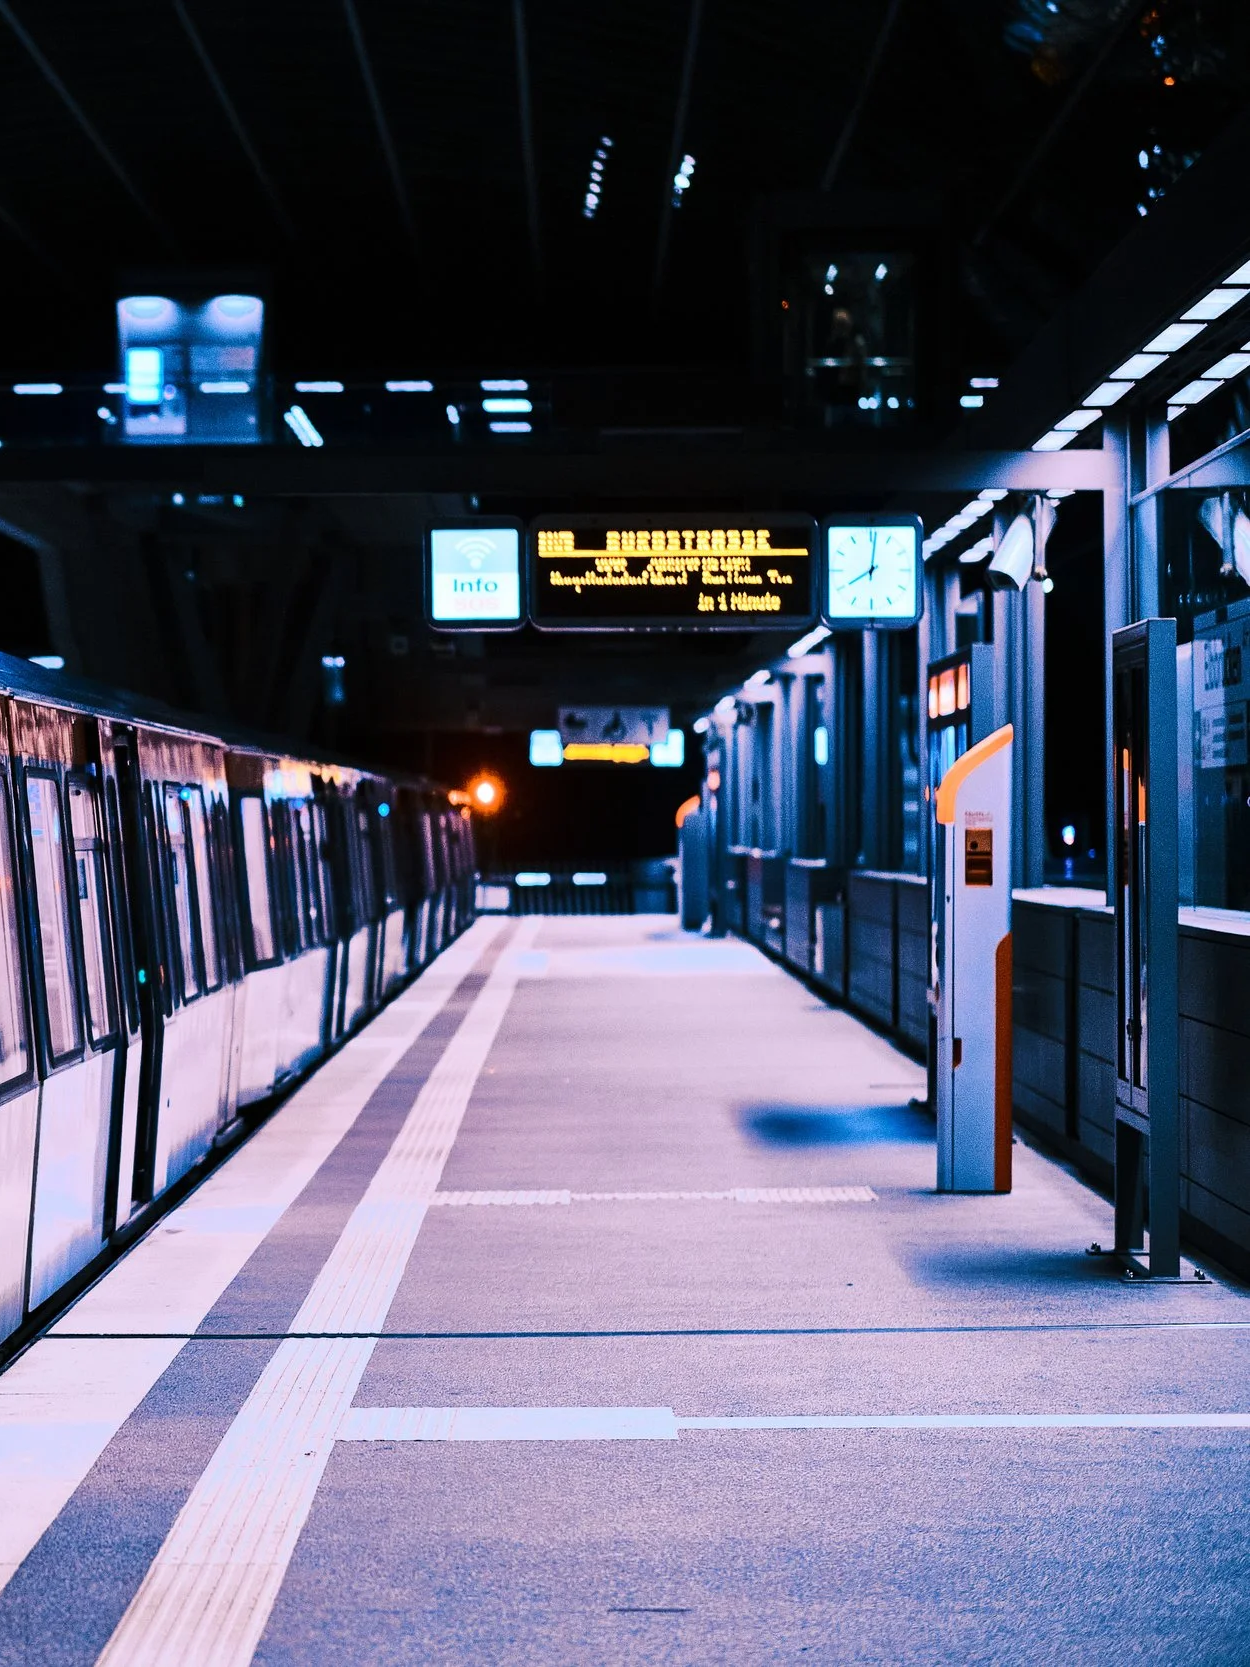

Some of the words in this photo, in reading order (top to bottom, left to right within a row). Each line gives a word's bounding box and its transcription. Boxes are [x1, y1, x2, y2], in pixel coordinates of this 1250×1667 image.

[606, 529, 771, 551] BURGSTRASSE
[453, 578, 498, 593] Info
[454, 597, 500, 611] SOS
[731, 591, 781, 611] Minute
